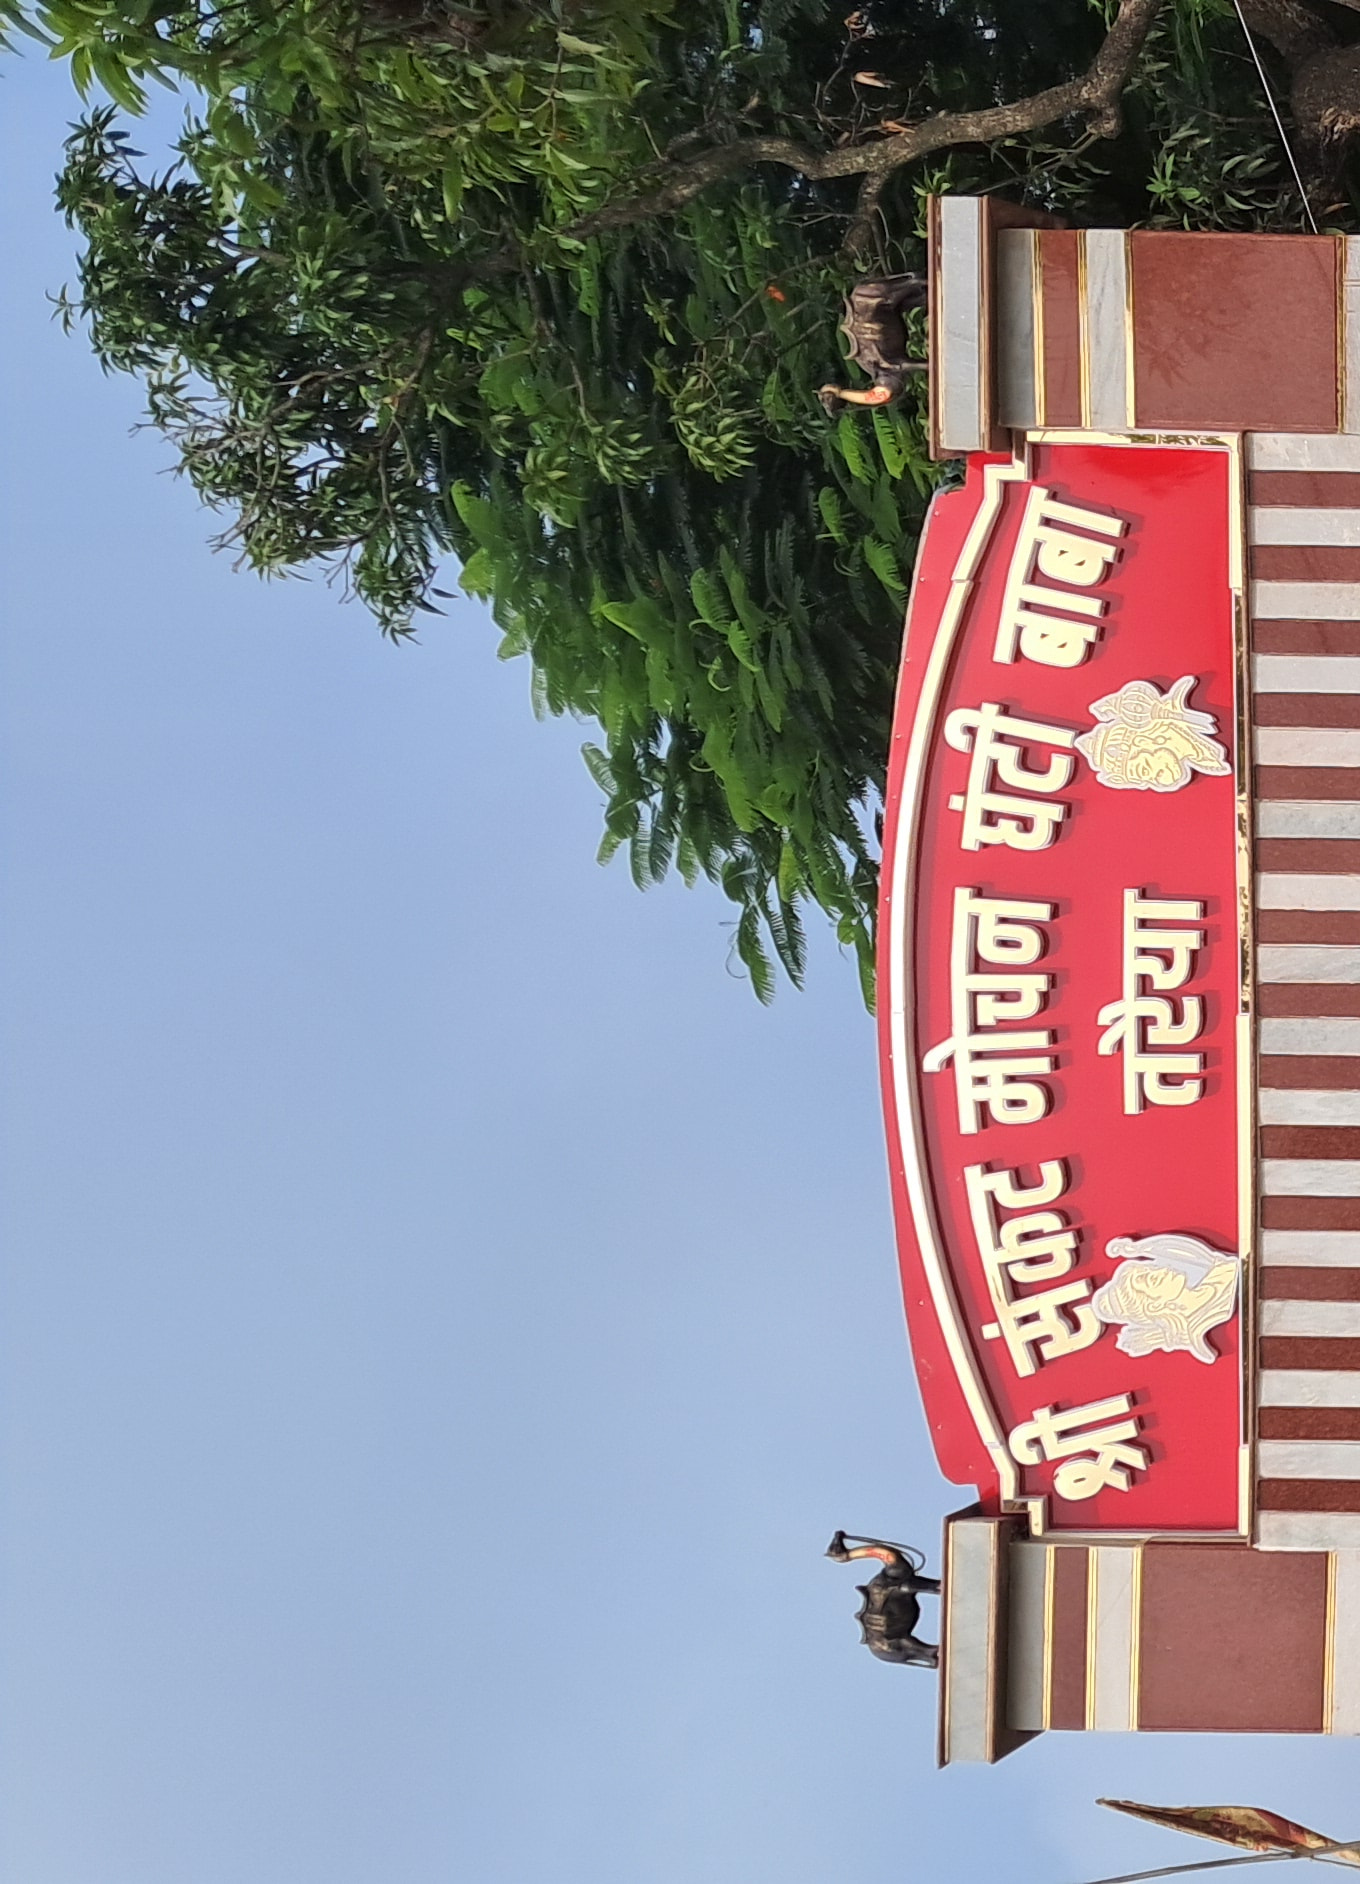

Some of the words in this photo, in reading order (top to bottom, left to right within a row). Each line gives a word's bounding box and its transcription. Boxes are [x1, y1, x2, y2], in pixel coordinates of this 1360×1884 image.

[993, 486, 1128, 669] बाबा
[944, 703, 1077, 852] घंटी
[924, 887, 1059, 1133] मोचन
[1099, 889, 1206, 1114] तरैया
[962, 1160, 1102, 1375] संकट
[1008, 1392, 1148, 1500] श्री
